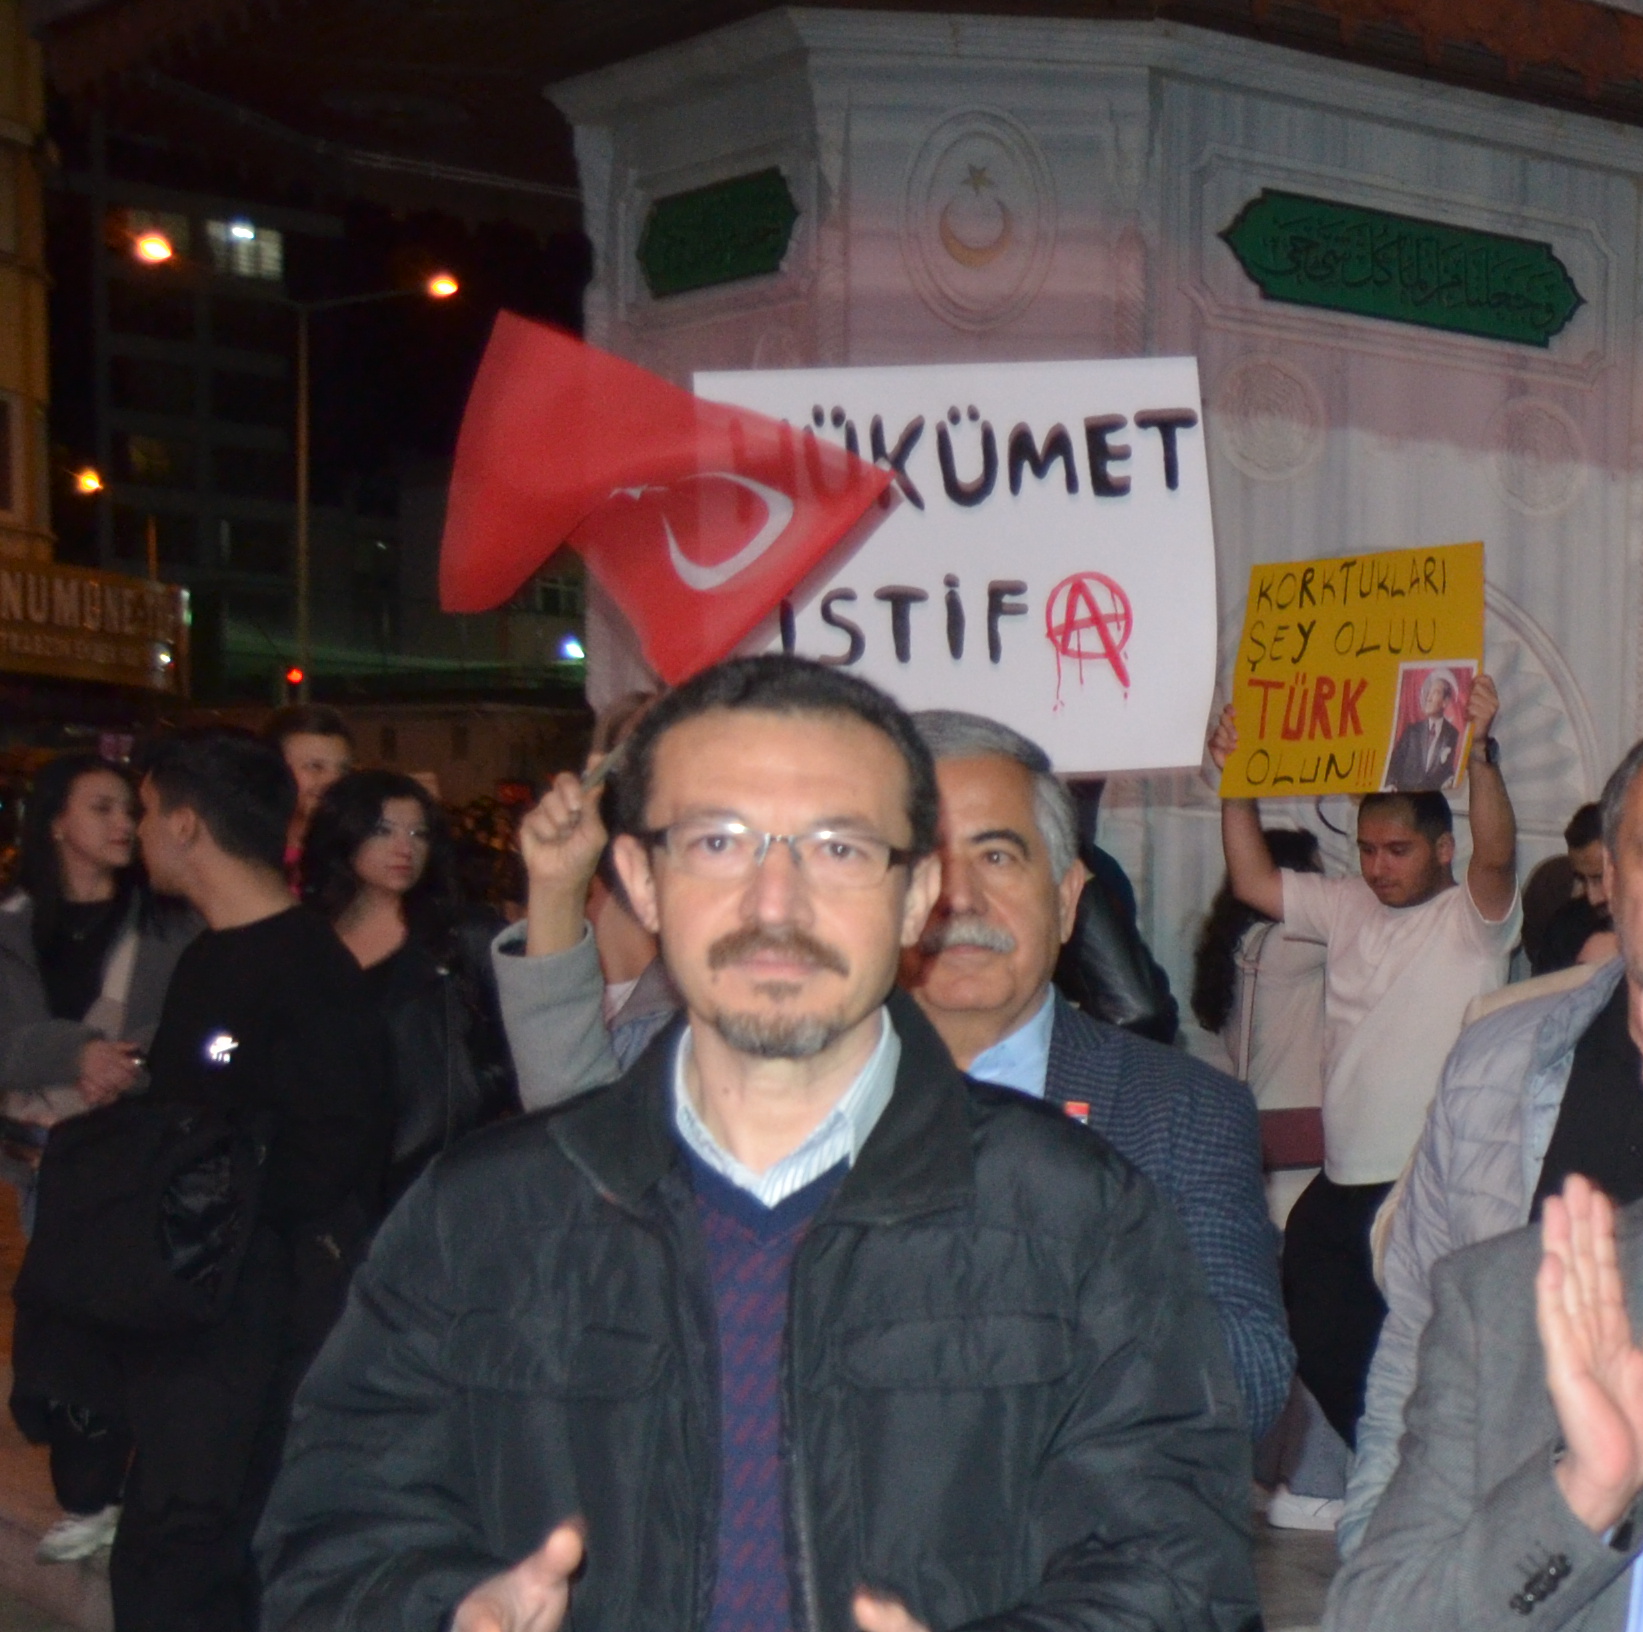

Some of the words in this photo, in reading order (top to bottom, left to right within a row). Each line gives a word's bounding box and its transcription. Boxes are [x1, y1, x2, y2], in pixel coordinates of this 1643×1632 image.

[1256, 556, 1446, 612] KORKTUKLARI
[1247, 620, 1316, 672] ŞEY
[1334, 618, 1436, 657] OLUN
[1248, 672, 1368, 741] TÜRK
